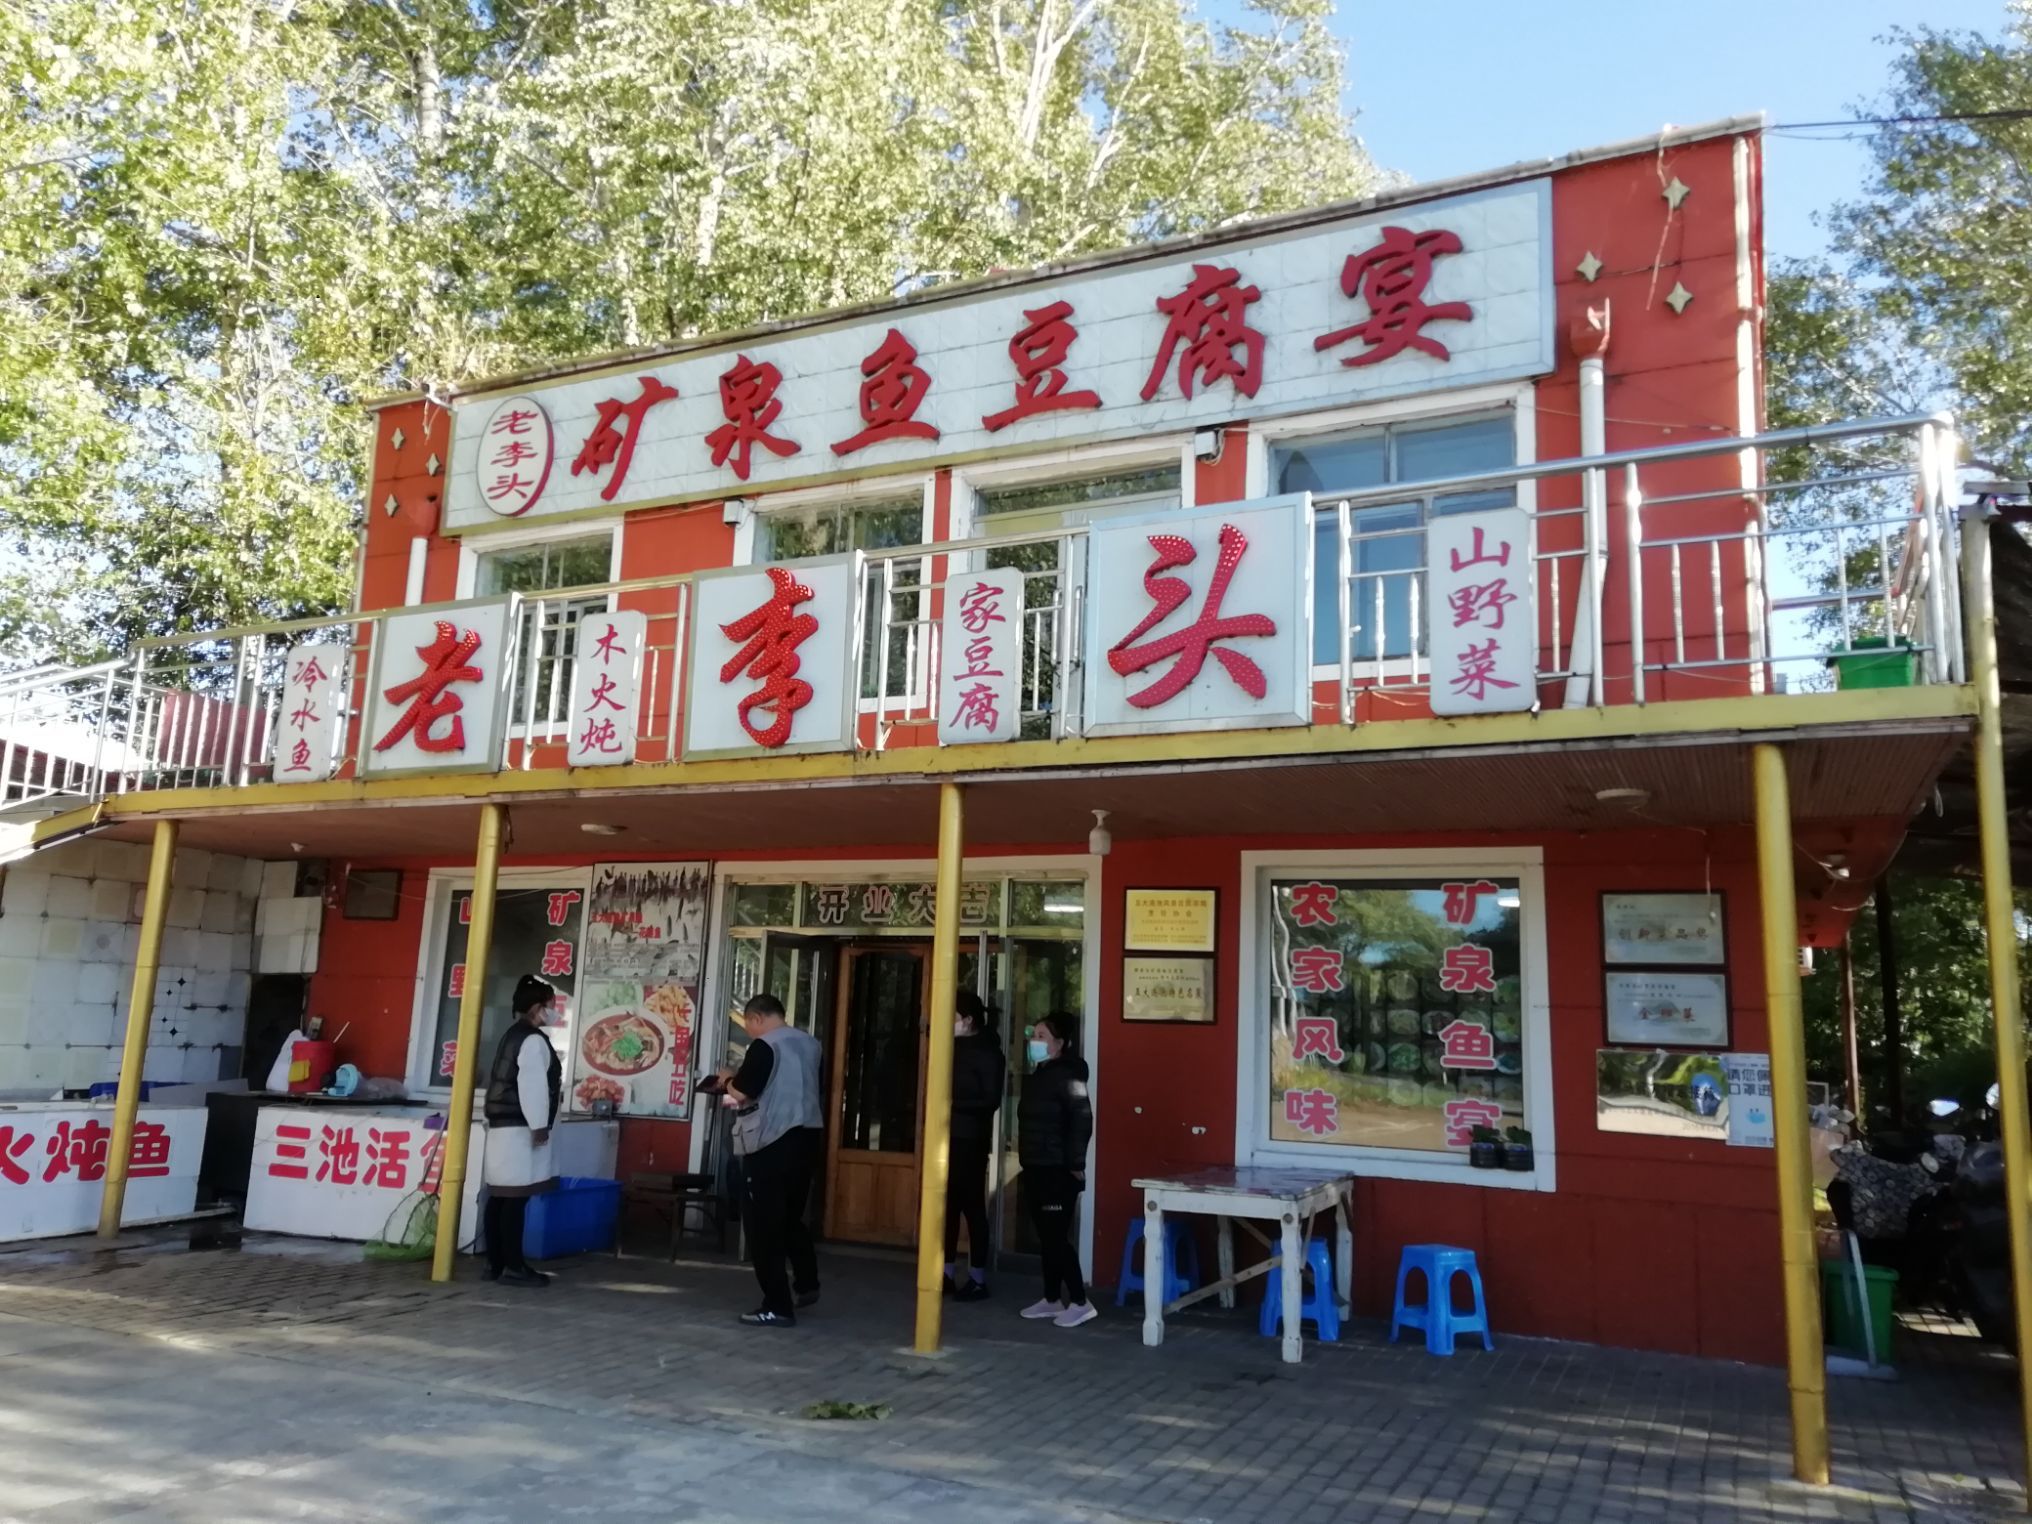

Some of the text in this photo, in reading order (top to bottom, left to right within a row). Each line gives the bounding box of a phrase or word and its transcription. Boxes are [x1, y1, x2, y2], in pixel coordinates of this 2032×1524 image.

[571, 226, 1473, 500] 矿泉鱼豆腐宴
[487, 409, 538, 501] 老李头
[374, 620, 484, 752] 老
[578, 623, 628, 756] 木火炖
[718, 567, 819, 748] 李
[949, 582, 1006, 735] 家豆腐
[1107, 523, 1277, 709] 头
[1448, 526, 1520, 701] 山野菜
[282, 655, 328, 774] 冷水鱼
[1284, 882, 1344, 1136] 农家风味
[1439, 880, 1503, 1147] 矿泉鱼宴
